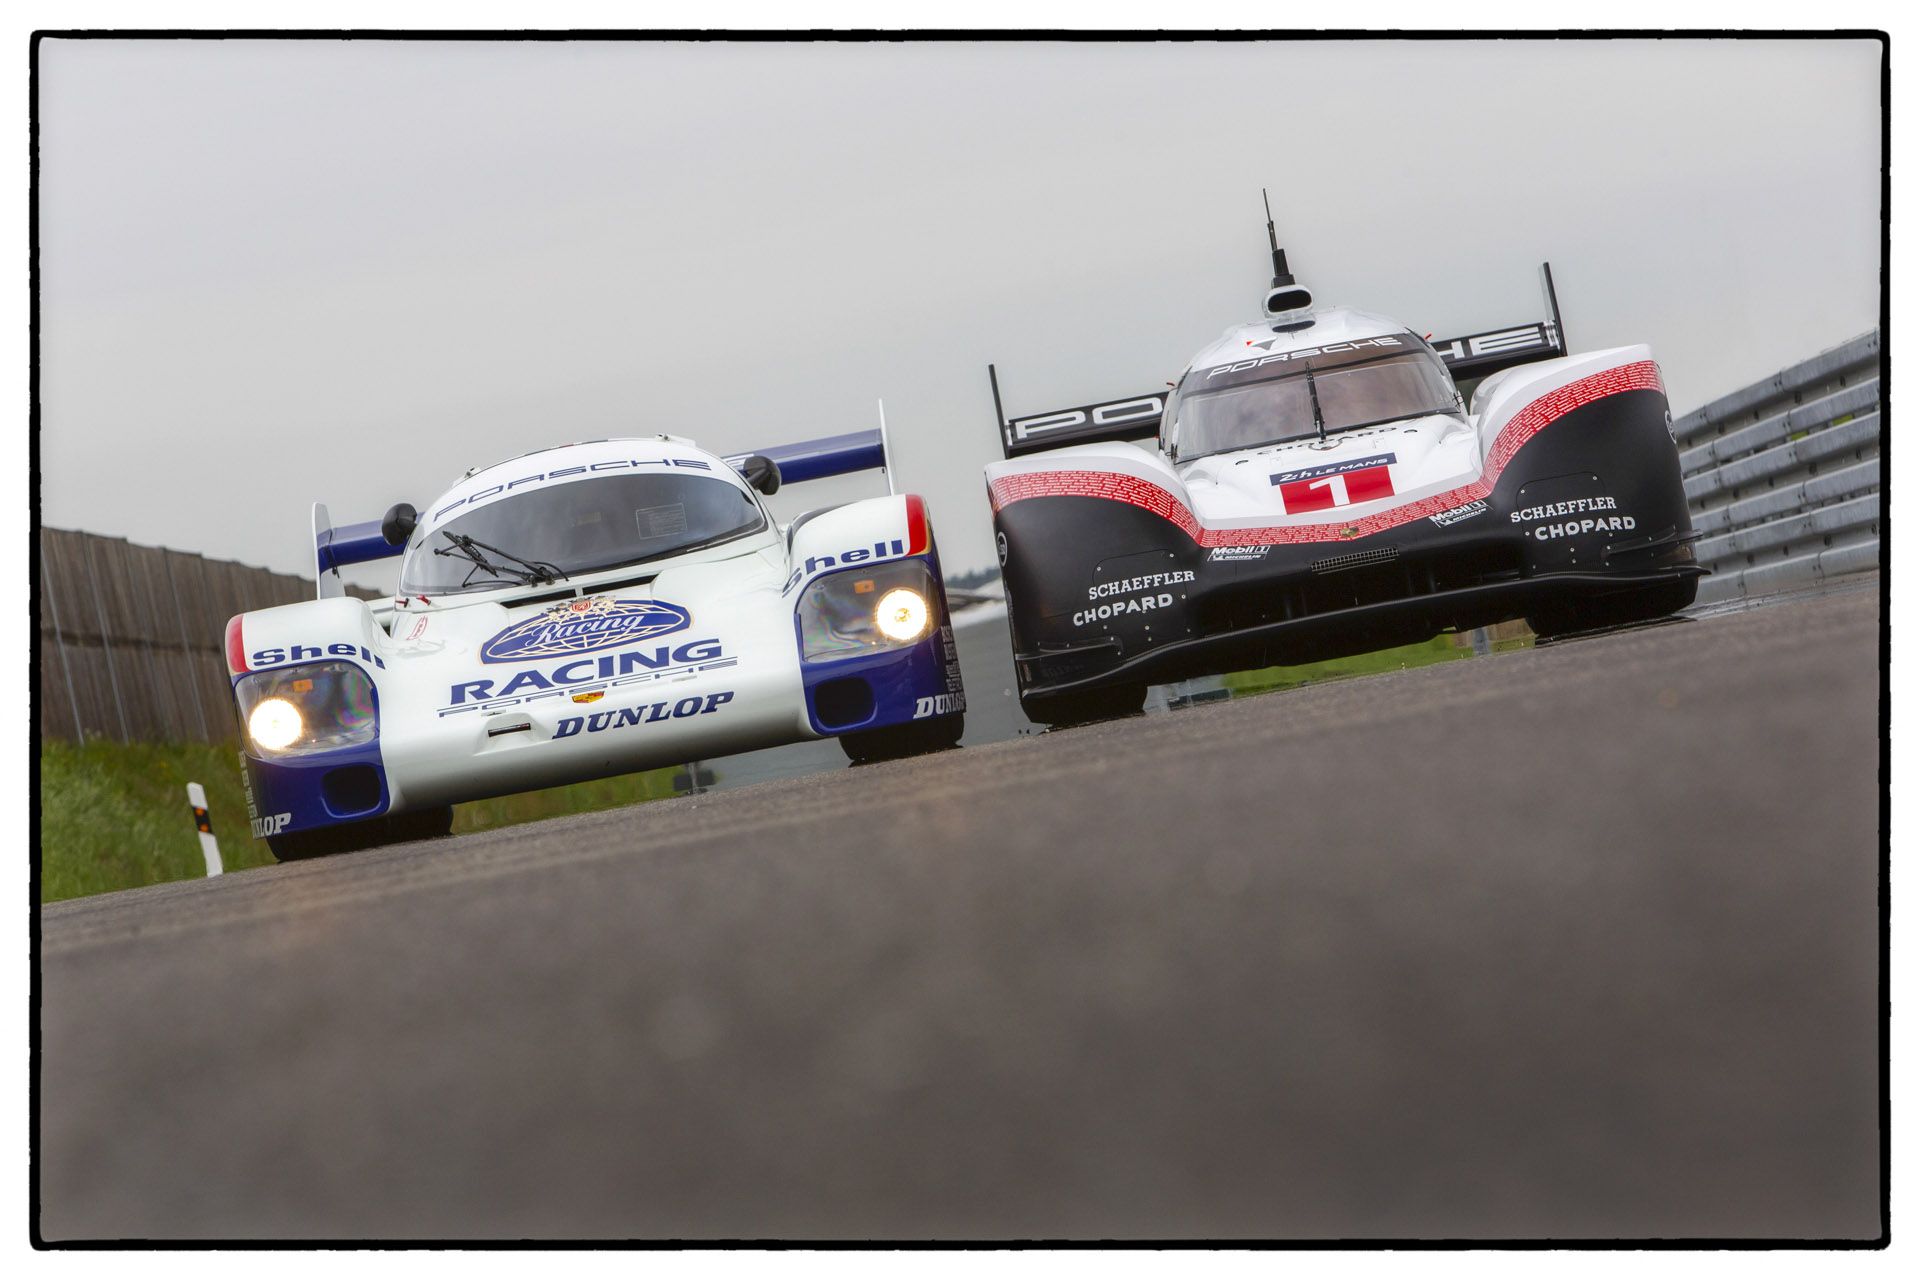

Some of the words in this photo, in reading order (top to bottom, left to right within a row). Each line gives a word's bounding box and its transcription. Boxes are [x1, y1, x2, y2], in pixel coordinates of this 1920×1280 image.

[1206, 336, 1402, 380] PORSCHE
[1316, 467, 1336, 475] LE
[1339, 458, 1388, 471] MANS
[433, 458, 712, 523] PORSCHE
[1309, 474, 1351, 507] 1
[1429, 504, 1472, 522] Mobil
[1510, 497, 1617, 524] SCHAEFFLER
[1535, 516, 1636, 541] CHOPARD
[1211, 545, 1256, 555] Mobil
[782, 539, 904, 598] Shell
[1089, 570, 1195, 600] SCHAEFFLER
[1073, 593, 1173, 626] CHOPARD
[525, 612, 644, 647] Racing
[252, 643, 386, 670] Shell
[450, 638, 722, 706] RACING
[551, 690, 735, 740] DUNLOP
